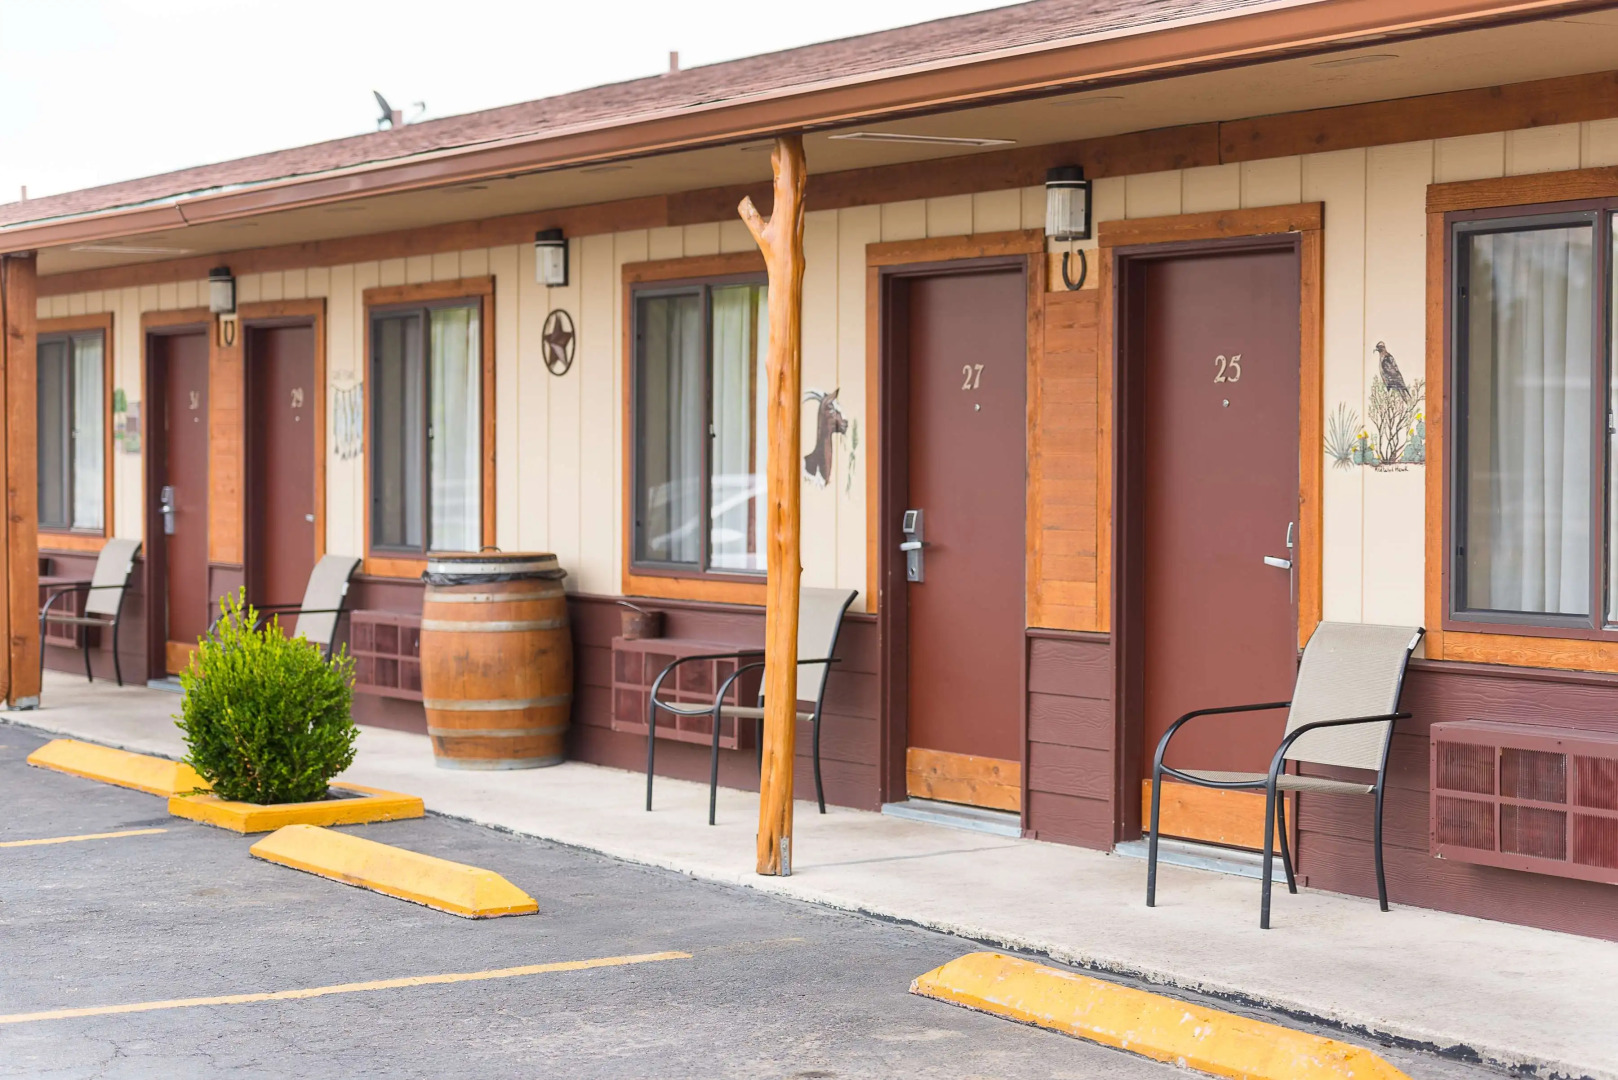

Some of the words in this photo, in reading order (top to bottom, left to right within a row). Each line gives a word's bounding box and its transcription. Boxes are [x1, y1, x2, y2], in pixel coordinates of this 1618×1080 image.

[961, 364, 984, 390] 27
[1214, 354, 1241, 383] 25
[290, 387, 304, 408] 29
